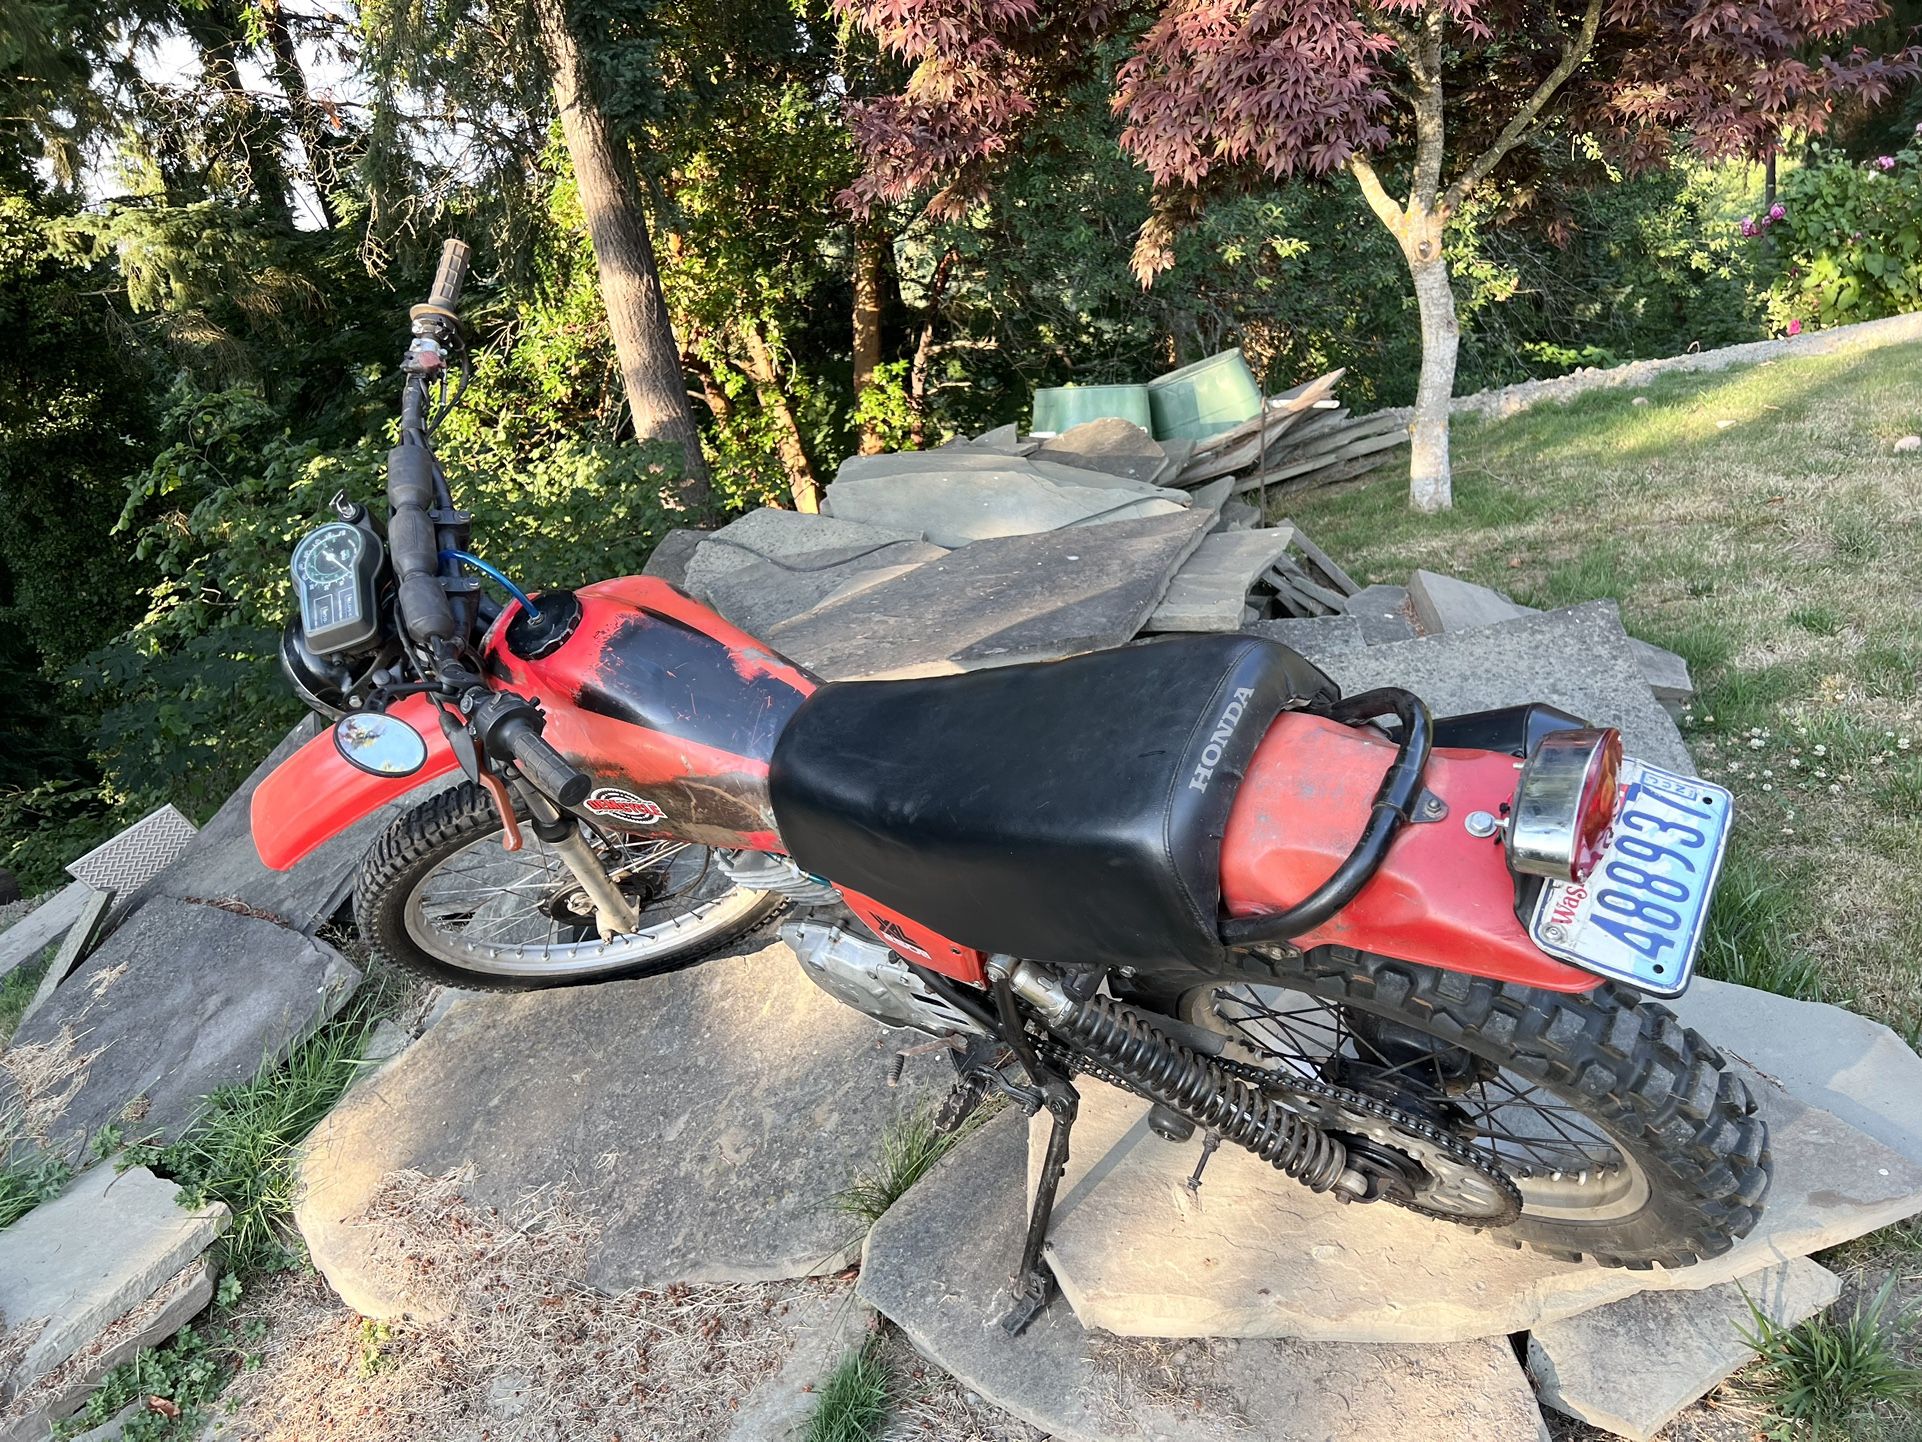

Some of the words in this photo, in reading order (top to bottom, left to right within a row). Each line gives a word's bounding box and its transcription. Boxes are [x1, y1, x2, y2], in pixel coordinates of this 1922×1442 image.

[1188, 687, 1255, 794] HONDA
[1550, 883, 1588, 926] Was
[1589, 783, 1711, 960] 488937
